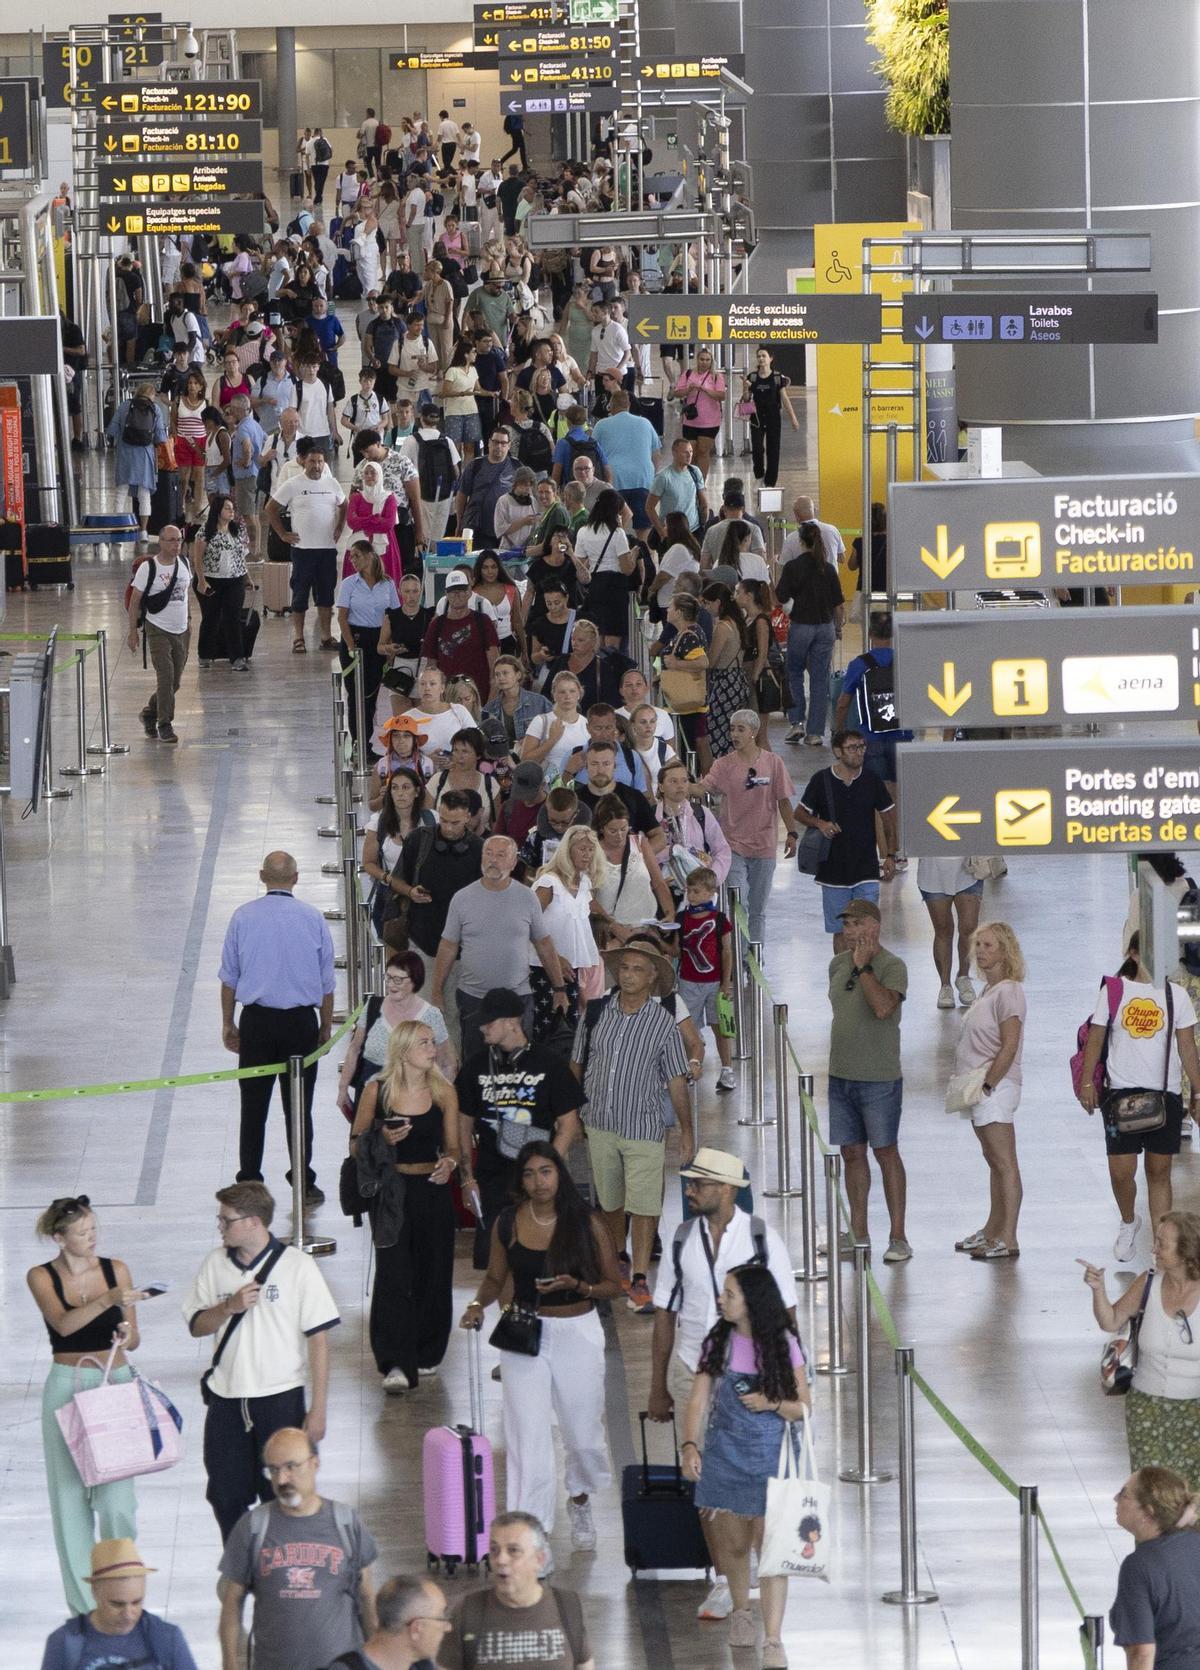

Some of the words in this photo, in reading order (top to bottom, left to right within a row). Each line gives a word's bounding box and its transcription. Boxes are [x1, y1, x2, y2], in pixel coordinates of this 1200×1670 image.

[570, 36, 611, 50] 81:50
[61, 46, 92, 67] 50
[125, 47, 149, 64] 21
[571, 66, 612, 80] 41:10
[141, 87, 179, 95] Facturació
[142, 95, 169, 103] Check-in
[142, 103, 182, 111] Facturación
[142, 127, 179, 135] Facturació
[143, 142, 184, 151] Facturación
[185, 133, 240, 151] 81:10
[193, 166, 228, 174] Arribades
[193, 183, 226, 191] Llegadas
[145, 207, 186, 216] Equipatges
[187, 207, 221, 216] especials
[146, 224, 182, 233] Equipajes
[183, 223, 221, 232] especiales
[729, 303, 761, 315] Accés
[764, 303, 807, 314] exclusiu
[1029, 305, 1073, 316] Lavabos
[728, 316, 771, 327] Exclusive
[772, 317, 803, 327] access
[1030, 318, 1059, 328] Toilets
[729, 328, 767, 339] Acceso
[770, 328, 818, 339] exclusivo
[1030, 330, 1061, 341] Aseos
[1053, 491, 1178, 518] Facturació
[1054, 522, 1145, 546] Check-in
[1055, 546, 1194, 574] Facturación
[1117, 676, 1163, 690] aena
[1065, 768, 1137, 791] Portes
[1143, 766, 1200, 789] d'em
[1065, 795, 1155, 819] Boarding
[1066, 820, 1153, 844] Puertas
[1159, 820, 1187, 842] de
[1127, 1006, 1160, 1018] Chupa
[1125, 1015, 1158, 1033] Chups
[260, 1541, 345, 1577] CARDIFF
